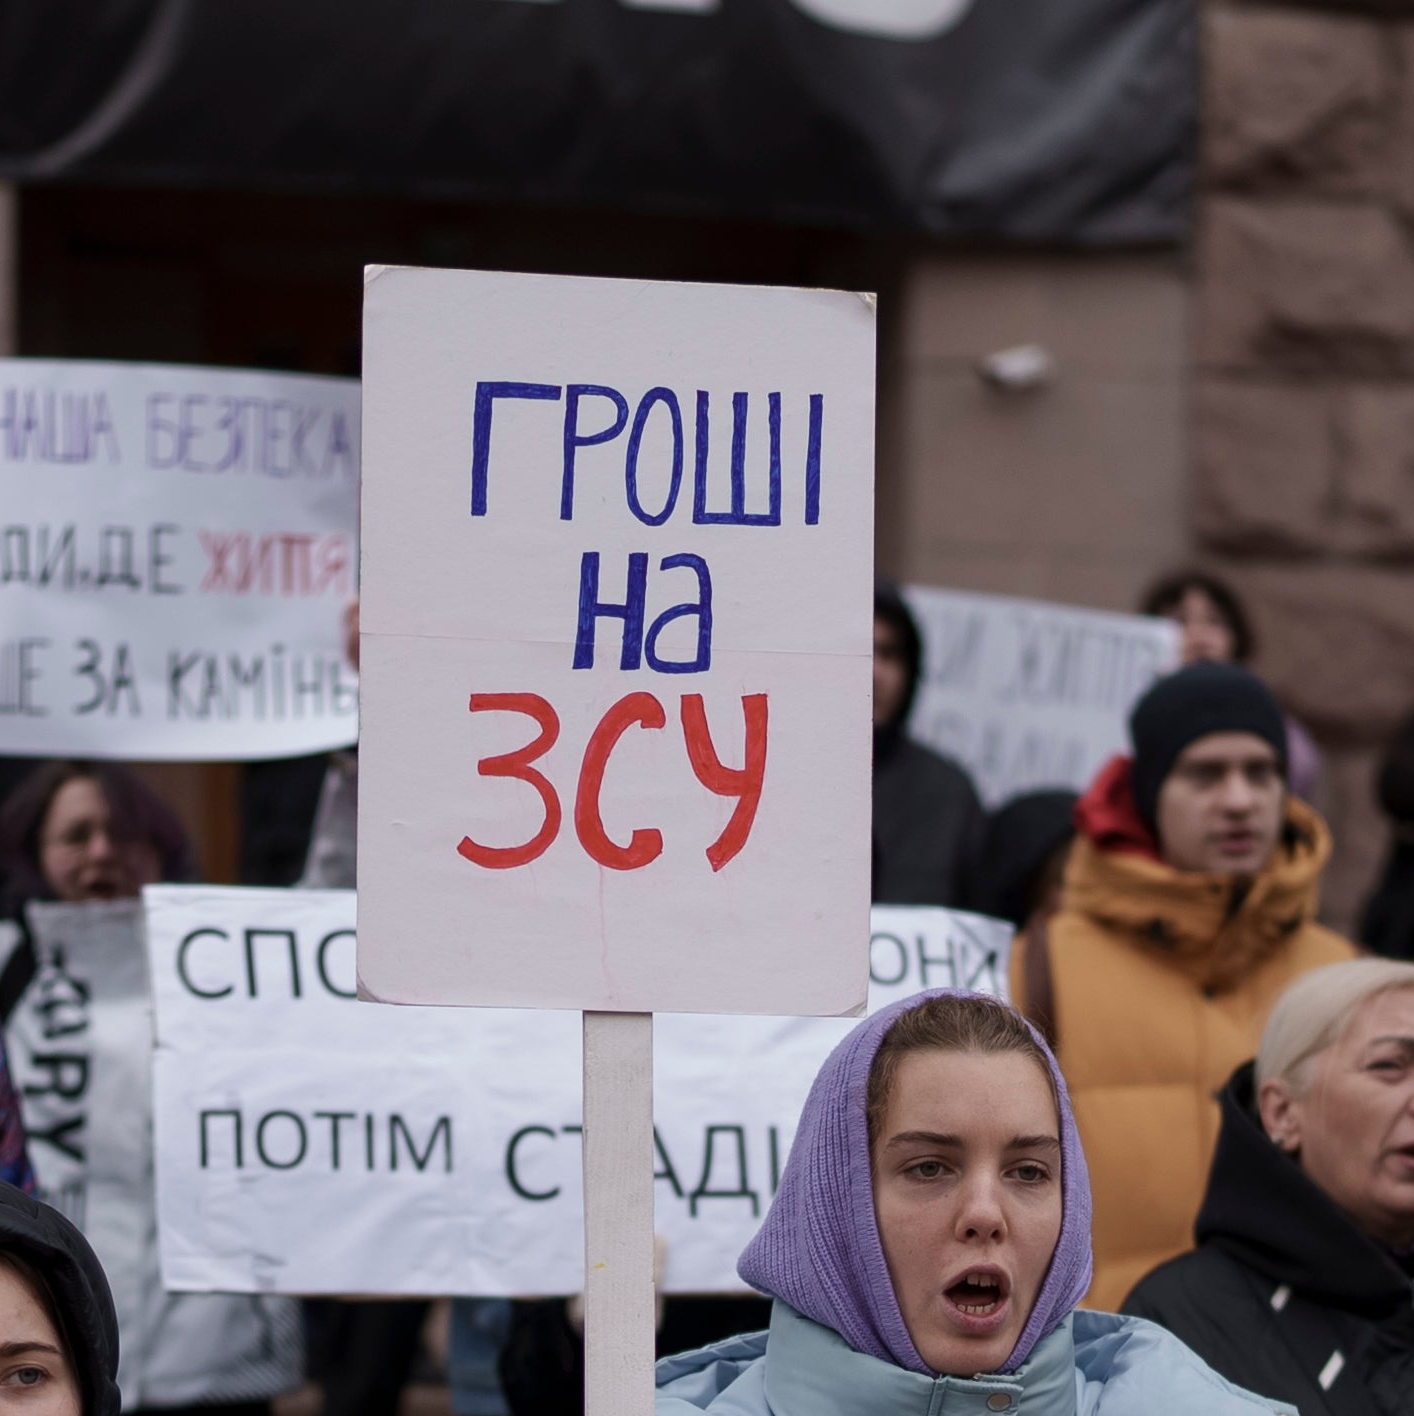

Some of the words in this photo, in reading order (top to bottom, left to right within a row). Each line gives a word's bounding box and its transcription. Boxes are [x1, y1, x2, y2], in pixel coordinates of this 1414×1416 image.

[145, 392, 357, 480] БЕЗПЕКА
[471, 381, 824, 527] ГРОШІ
[71, 636, 142, 719] ЗА
[457, 691, 769, 873] ЗСУ
[198, 1107, 455, 1175] ПОТІМ
[505, 1122, 783, 1219] САДІ
